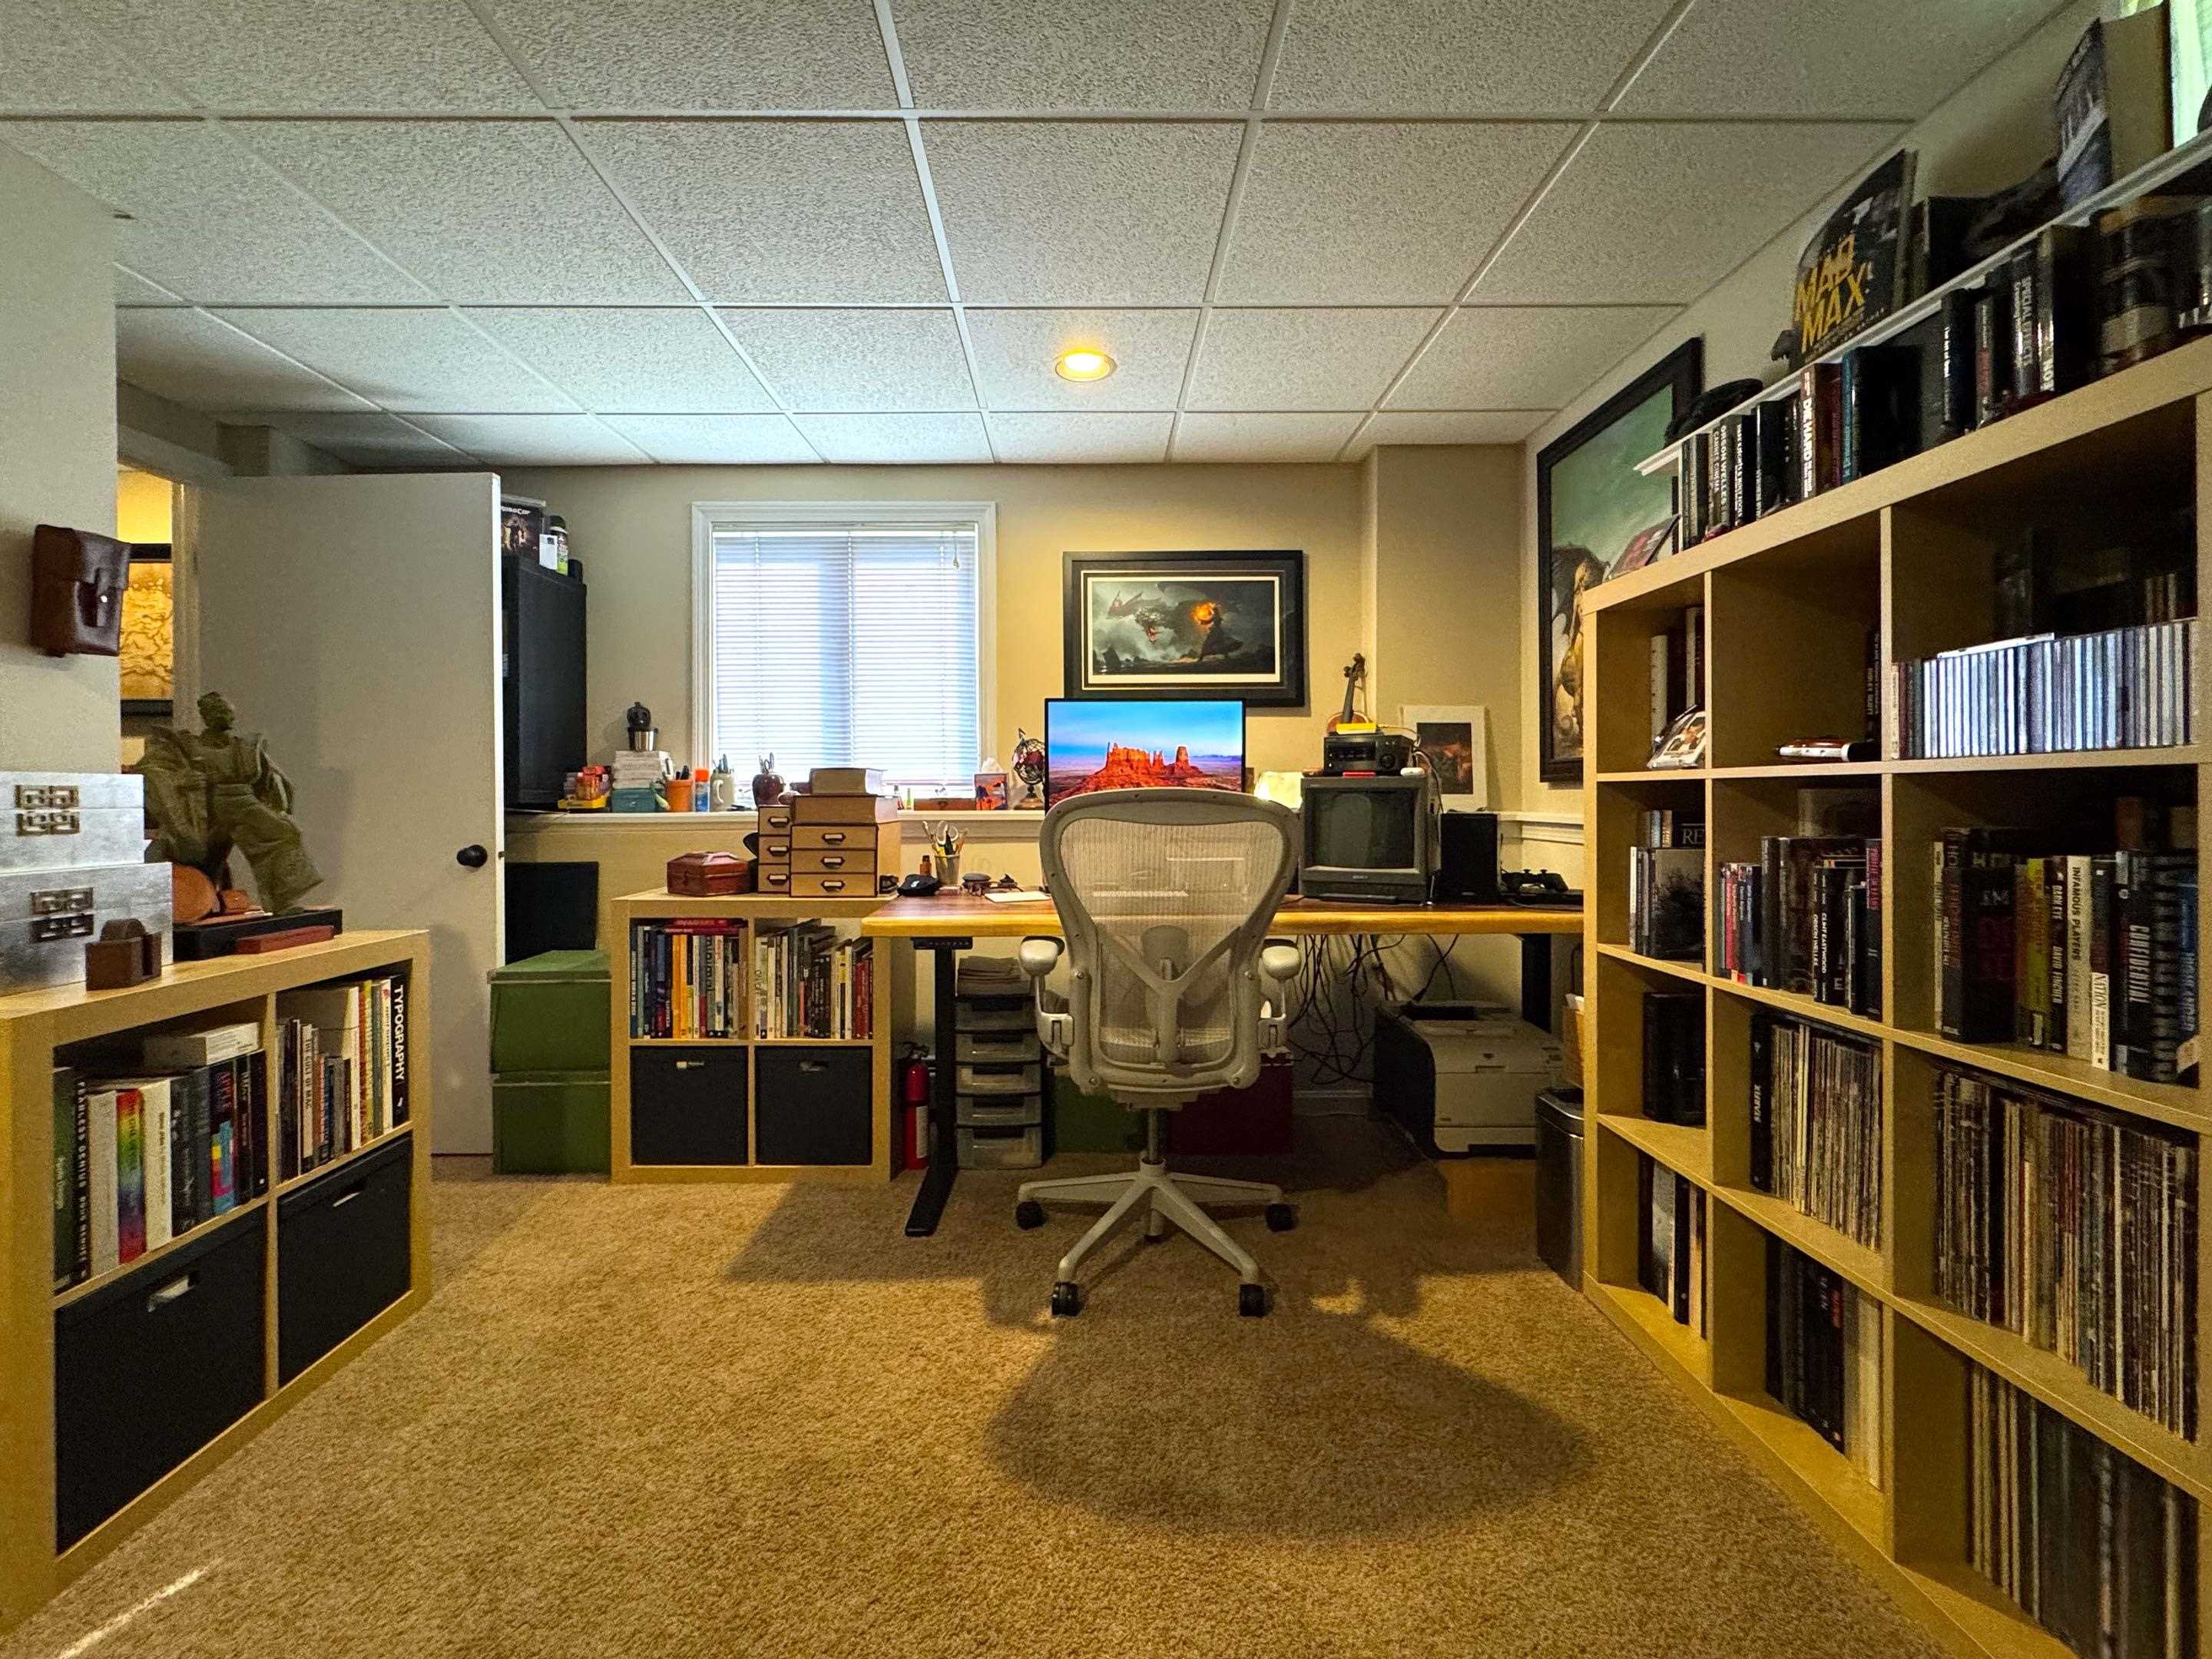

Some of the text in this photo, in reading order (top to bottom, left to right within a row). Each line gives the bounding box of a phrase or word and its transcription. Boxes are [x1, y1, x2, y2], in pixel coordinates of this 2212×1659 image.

[1793, 233, 1856, 326] MAD
[1802, 262, 1866, 353] MAX
[2021, 276, 2033, 366] SPECIAL EFFECTS
[1803, 398, 1813, 422] DIE
[1803, 422, 1813, 462] HARD
[2071, 866, 2081, 915] INFAMOUS
[2071, 918, 2081, 960] PLAYERS
[2128, 924, 2151, 1004] CONFIDENTIAL
[2052, 945, 2064, 1005] DAVID FINCHER
[2094, 975, 2108, 1008] NATION
[393, 984, 406, 1081] TYPOGRAPHY
[77, 1081, 87, 1141] FEARLESS
[78, 1144, 87, 1188] GENIUS
